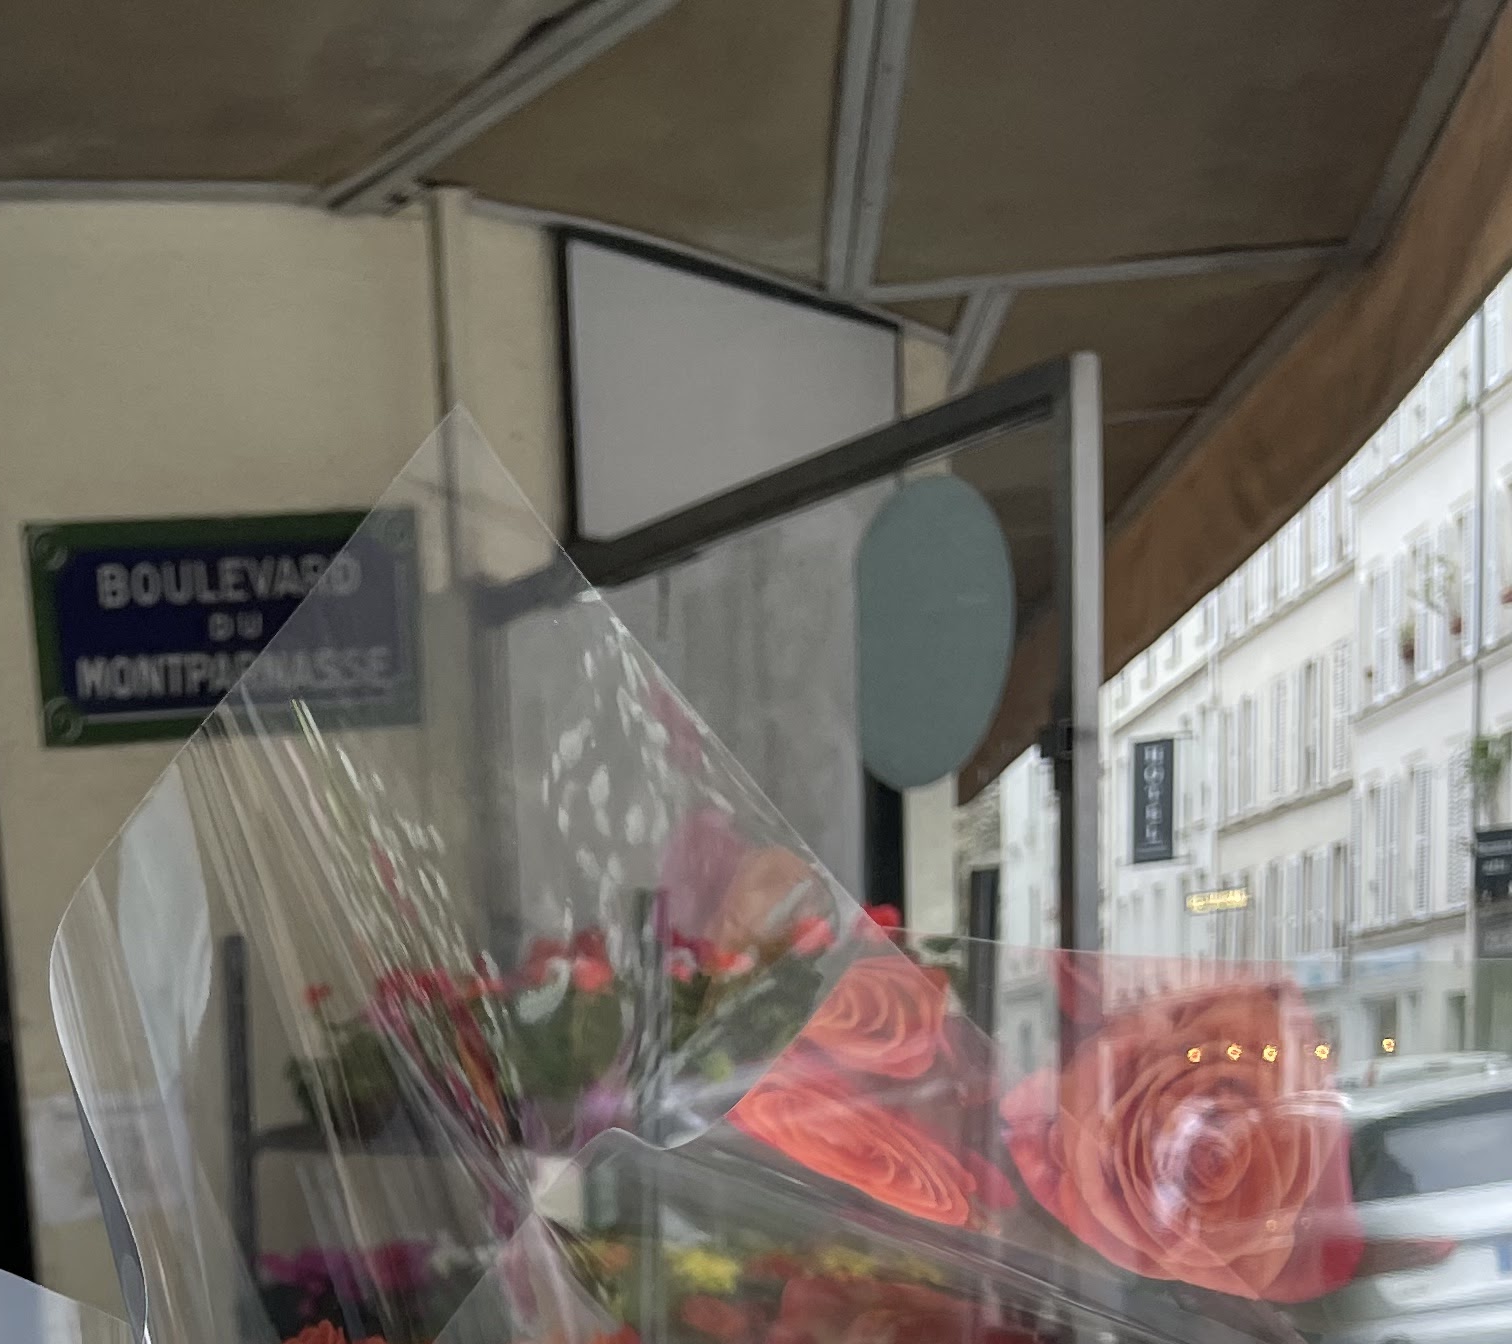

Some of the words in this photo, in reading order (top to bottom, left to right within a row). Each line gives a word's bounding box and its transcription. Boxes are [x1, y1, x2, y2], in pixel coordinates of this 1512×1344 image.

[96, 553, 363, 609] BOULEVARD
[208, 610, 264, 641] DU
[75, 645, 390, 700] MONTPARNASSE
